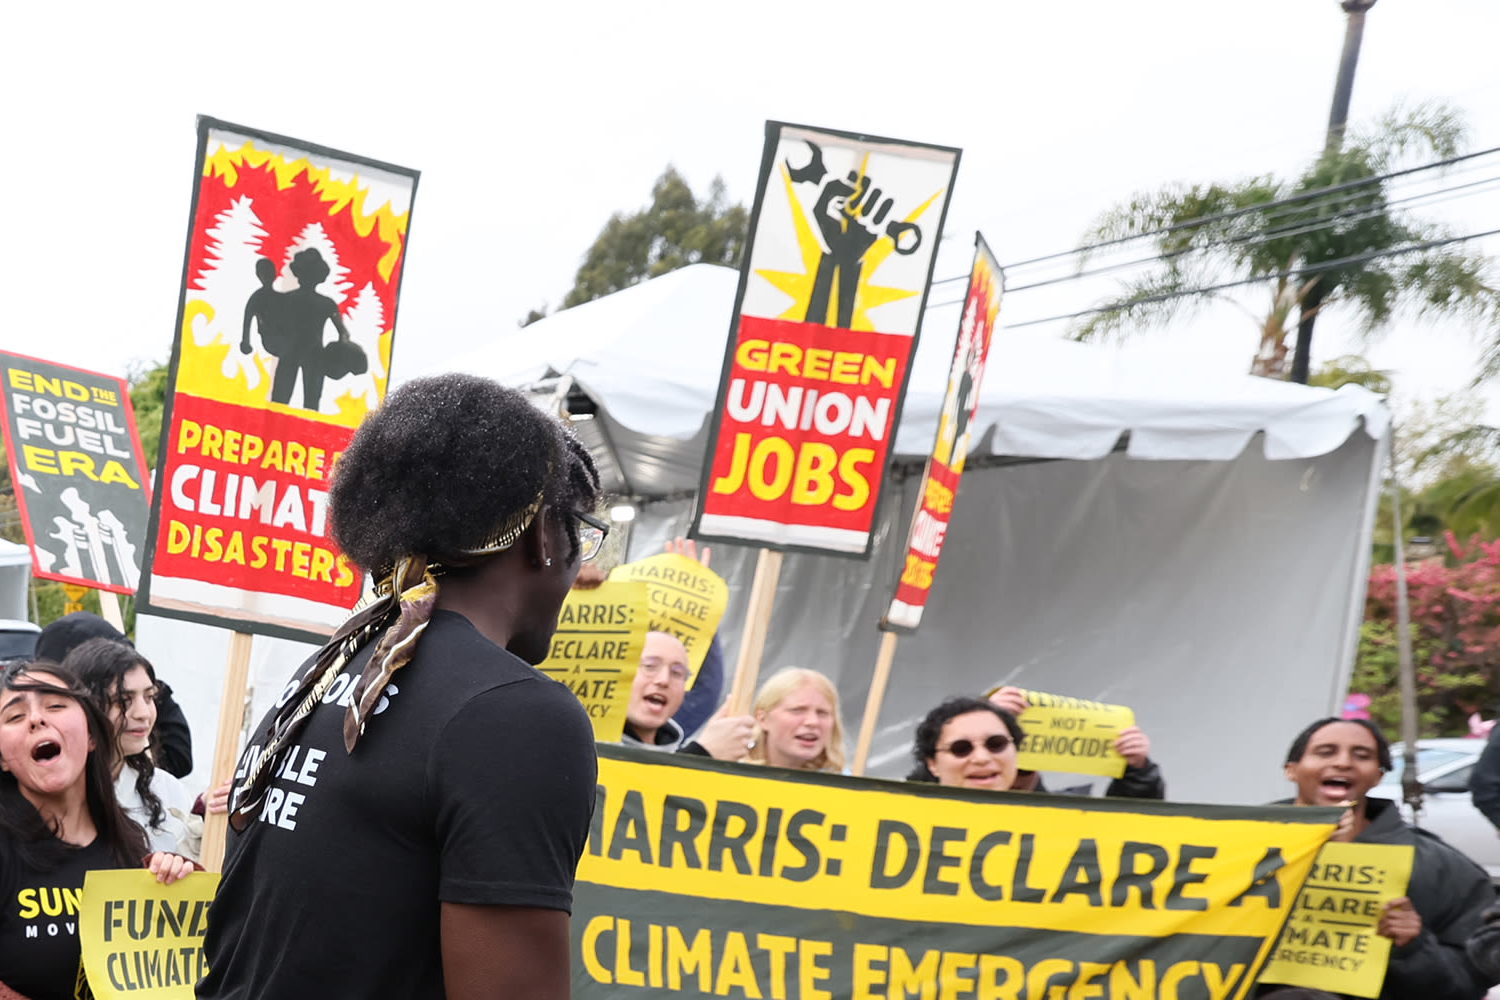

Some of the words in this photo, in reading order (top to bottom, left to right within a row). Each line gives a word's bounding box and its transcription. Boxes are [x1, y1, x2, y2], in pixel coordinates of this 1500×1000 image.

[7, 367, 90, 402] END
[90, 386, 117, 401] THE
[735, 339, 896, 388] GREEN
[12, 392, 125, 434] FOSSIL
[725, 378, 891, 441] UNION
[16, 416, 131, 459] FUEL
[177, 418, 325, 480] PREPARE
[22, 444, 140, 489] ERA
[712, 432, 875, 511] JOBS
[170, 464, 330, 537] CLIMAT
[167, 519, 354, 587] DISASTERS
[560, 604, 634, 625] ARRIS:
[651, 590, 709, 621] CLARE
[550, 640, 630, 660] ECLARE
[1050, 717, 1087, 731] NOT
[869, 819, 1217, 911] DECLARE
[1228, 847, 1289, 909] A
[1307, 863, 1386, 885] RRIS:
[1302, 894, 1380, 917] LARE
[1271, 949, 1365, 972] RGENCY
[1286, 927, 1372, 954] MATE
